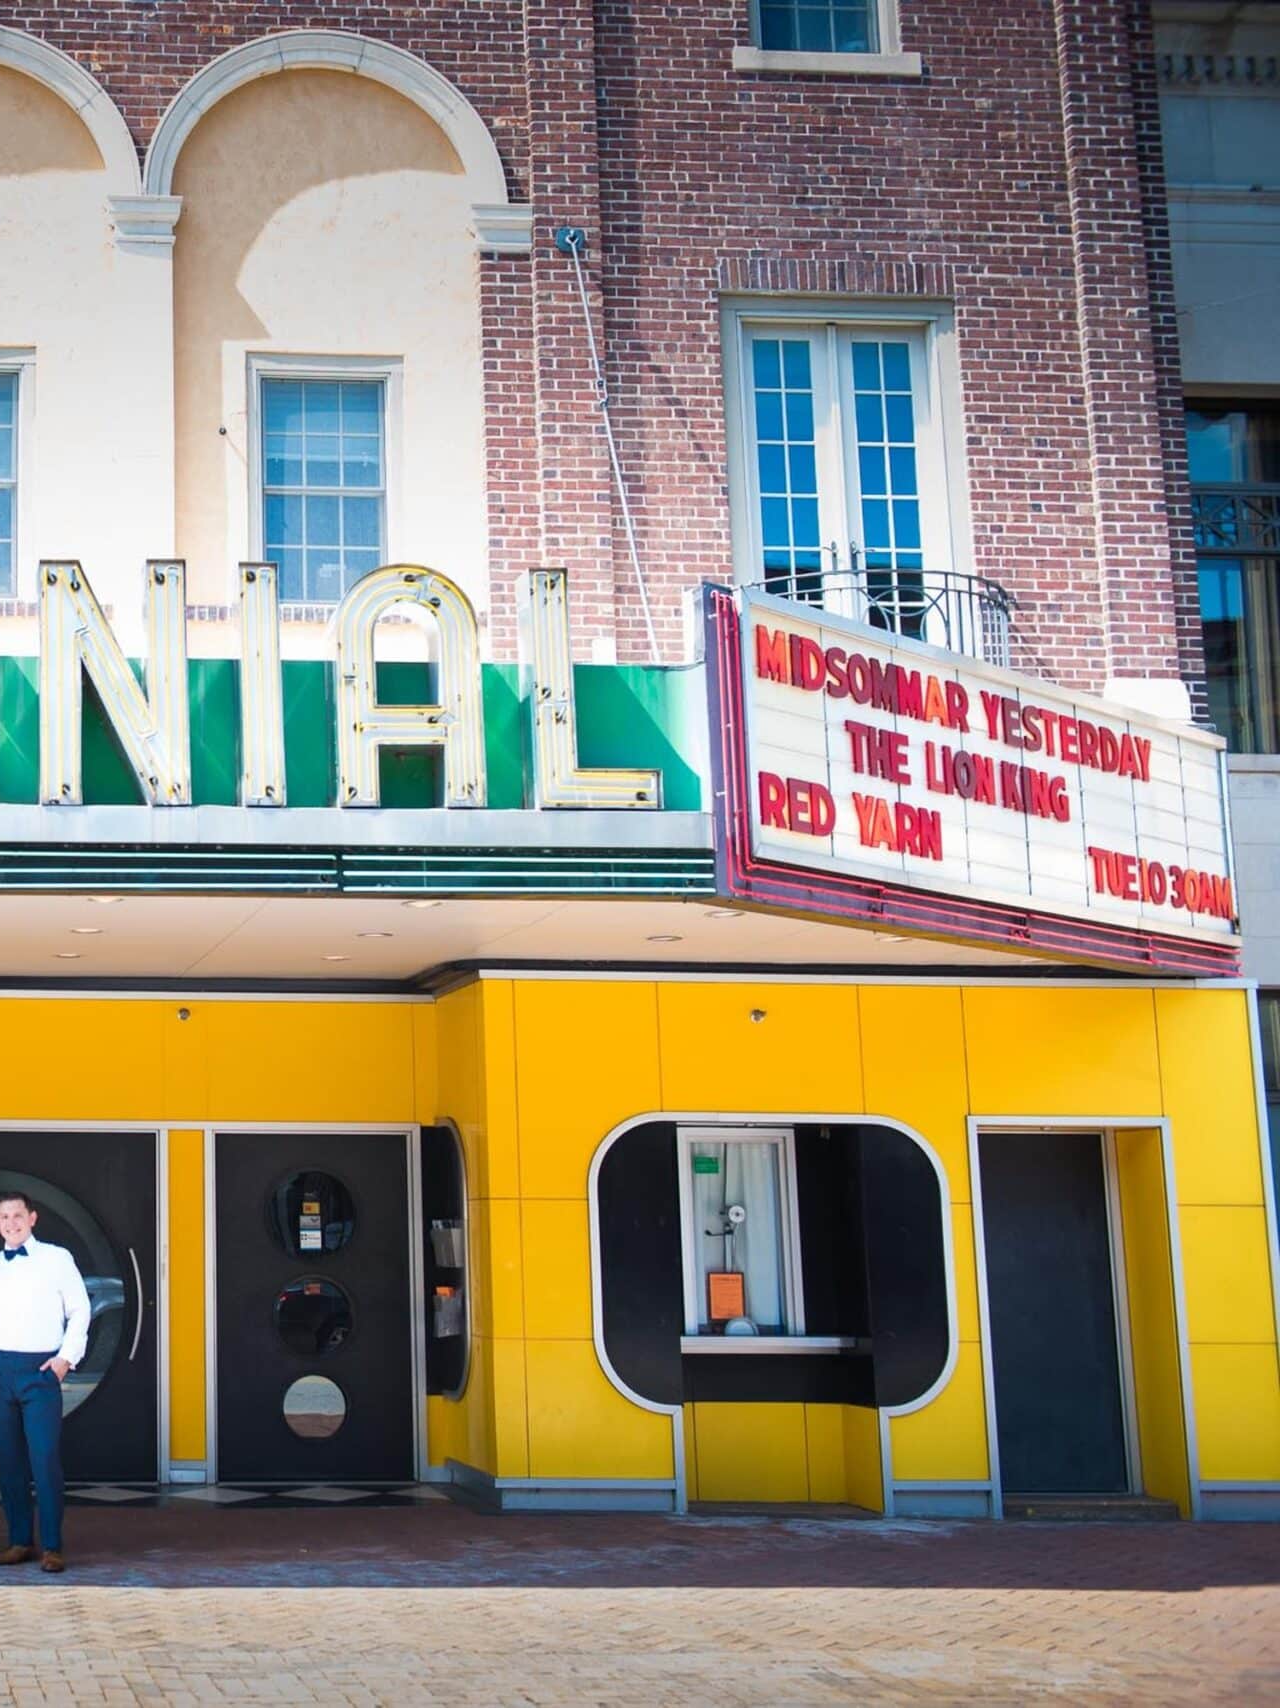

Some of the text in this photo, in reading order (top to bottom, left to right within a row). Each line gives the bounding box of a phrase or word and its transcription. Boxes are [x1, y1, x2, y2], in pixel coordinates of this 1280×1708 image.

[756, 624, 1152, 783] MIDSOMMAR YESTERDAY
[758, 771, 944, 861] RED YARN
[845, 720, 1070, 823] THE LION KING
[1088, 845, 1139, 902] TUE
